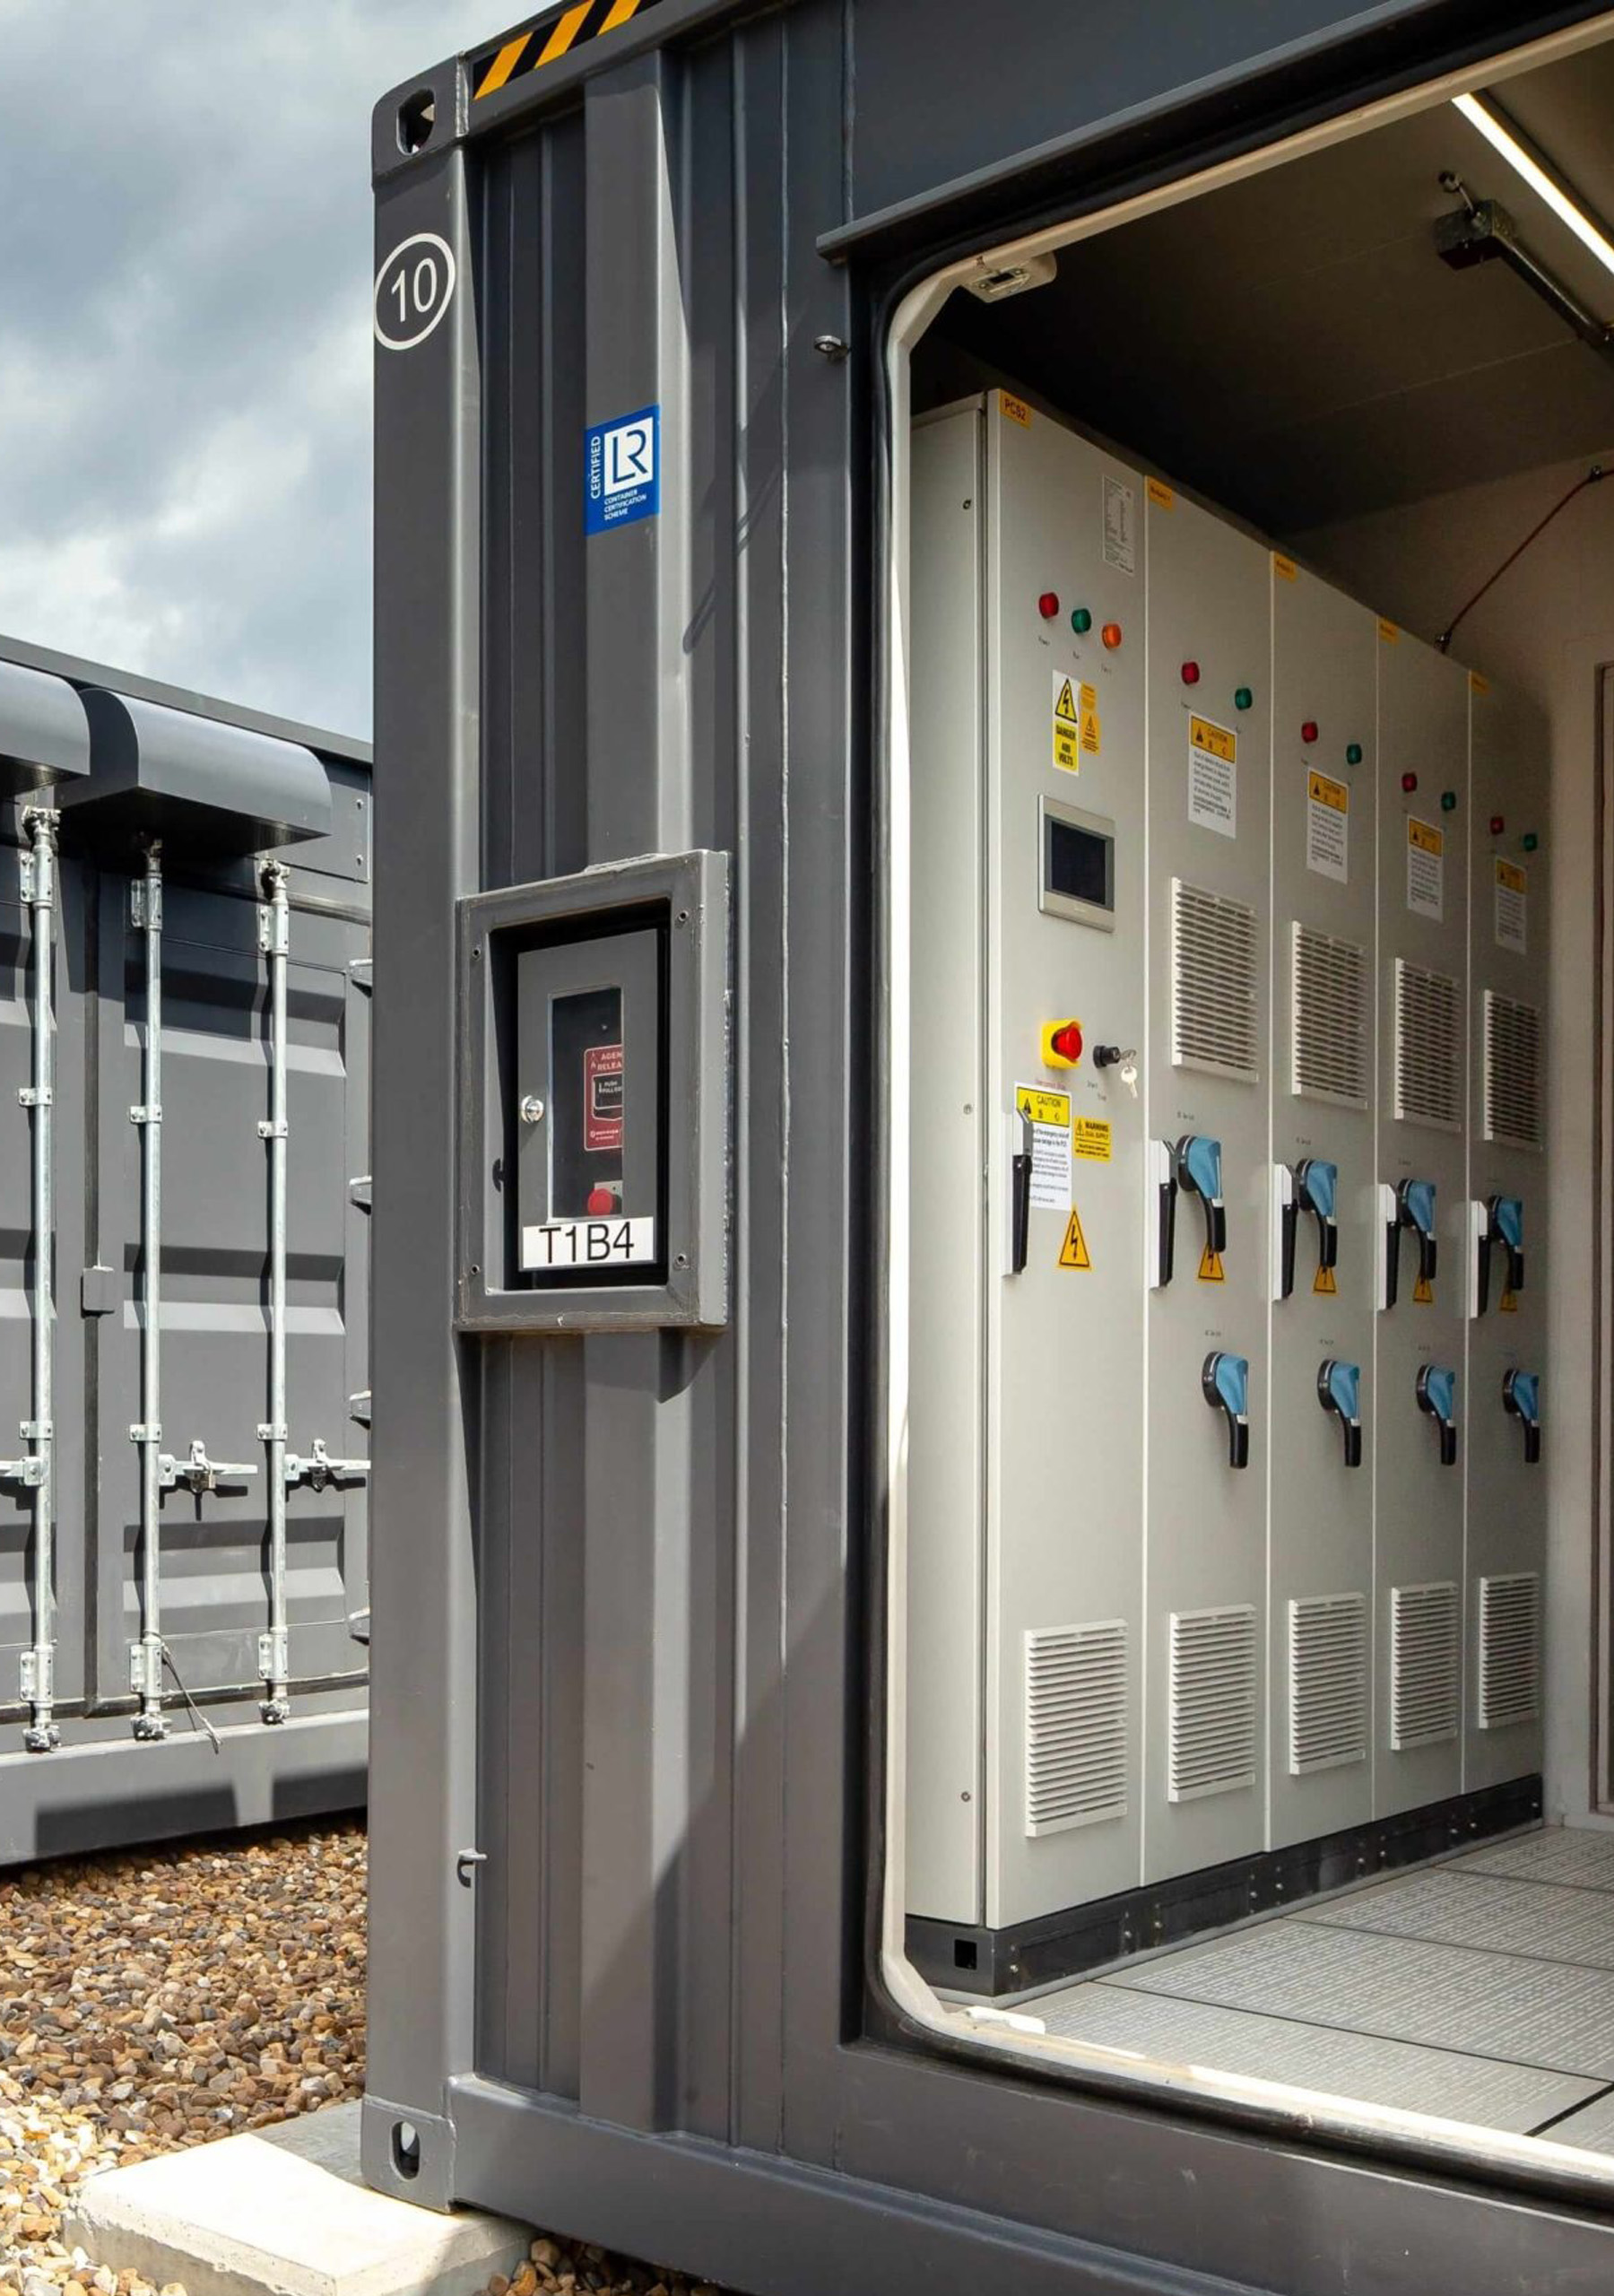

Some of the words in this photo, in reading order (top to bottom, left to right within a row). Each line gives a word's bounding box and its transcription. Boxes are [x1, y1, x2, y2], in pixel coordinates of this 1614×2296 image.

[391, 257, 437, 322] 10
[612, 429, 648, 484] LR
[590, 436, 601, 500] CERTIFIED
[604, 489, 638, 505] CONTAINER
[604, 494, 646, 513] CERTIFICATION
[604, 508, 629, 520] SCHEME
[1055, 724, 1076, 741] DANGER
[1058, 752, 1073, 766] VOLTS
[1037, 1094, 1062, 1108] CAUTION
[1085, 1121, 1109, 1132] WARNING
[539, 1221, 634, 1264] T1B4
